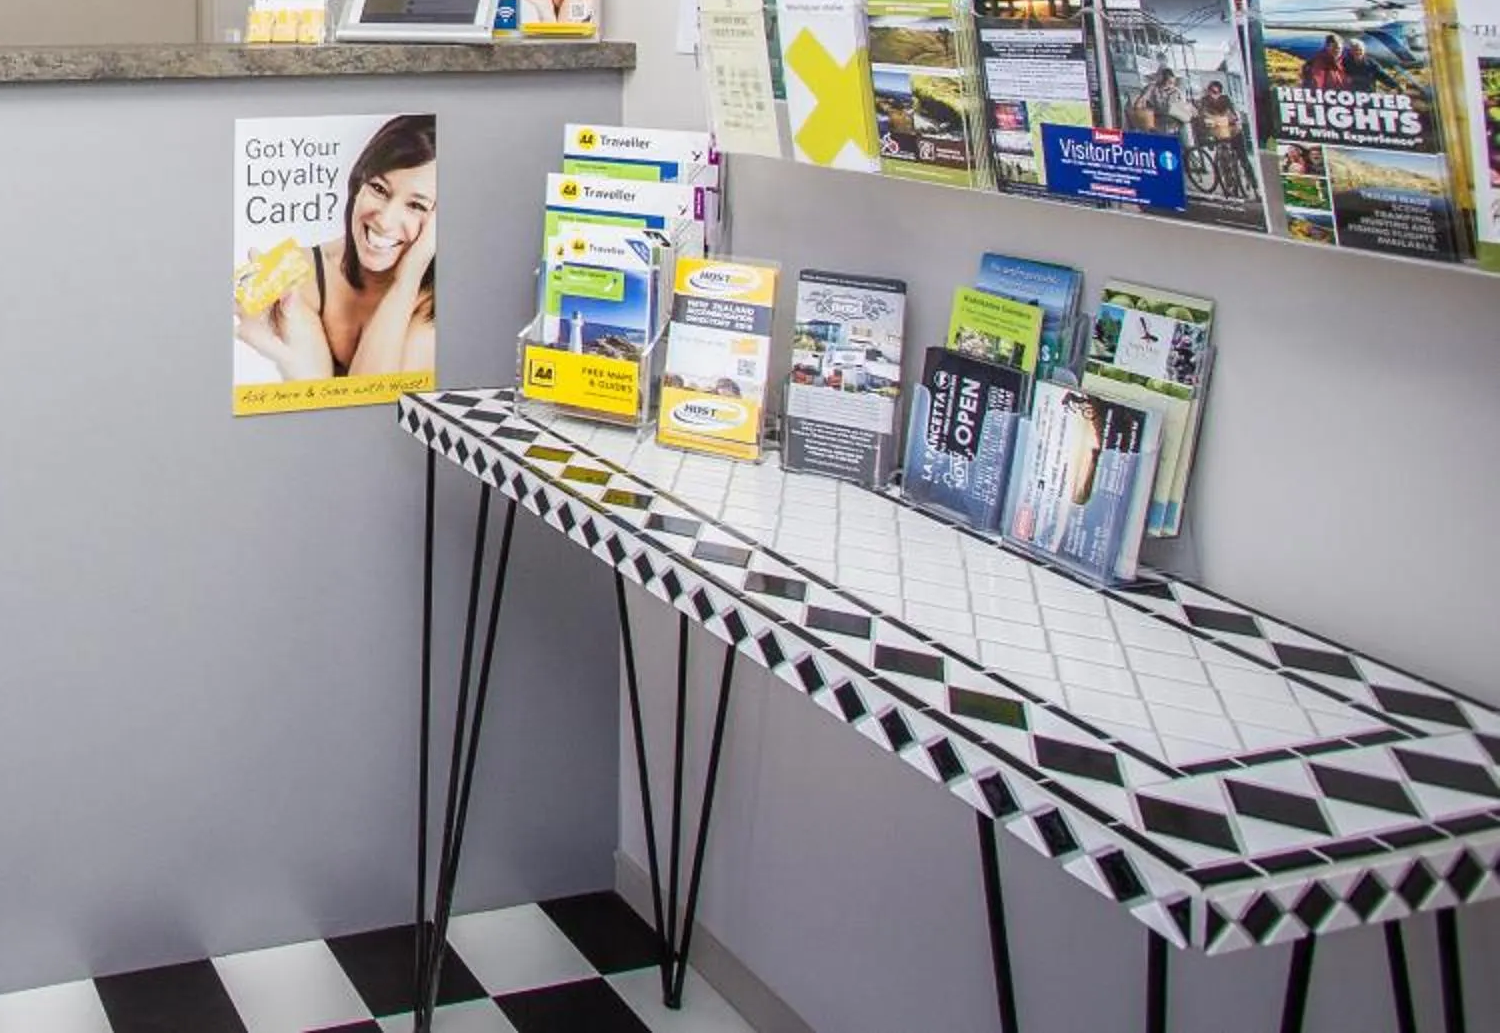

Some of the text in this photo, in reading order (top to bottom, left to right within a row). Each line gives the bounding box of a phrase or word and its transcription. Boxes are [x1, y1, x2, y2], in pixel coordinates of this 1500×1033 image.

[1276, 87, 1412, 110] HELICOPTER
[1279, 103, 1423, 136] FLIGHTS
[245, 136, 340, 159] Got Your
[600, 134, 652, 150] Traveller
[1059, 137, 1157, 170] VisitorPoint
[247, 163, 340, 194] Loyalty
[584, 185, 637, 203] Traveller
[245, 192, 339, 225] Card?
[589, 243, 626, 256] Traveller
[581, 366, 633, 383] FREE MAPS
[598, 379, 634, 394] GUIDES
[954, 377, 982, 446] OPEN
